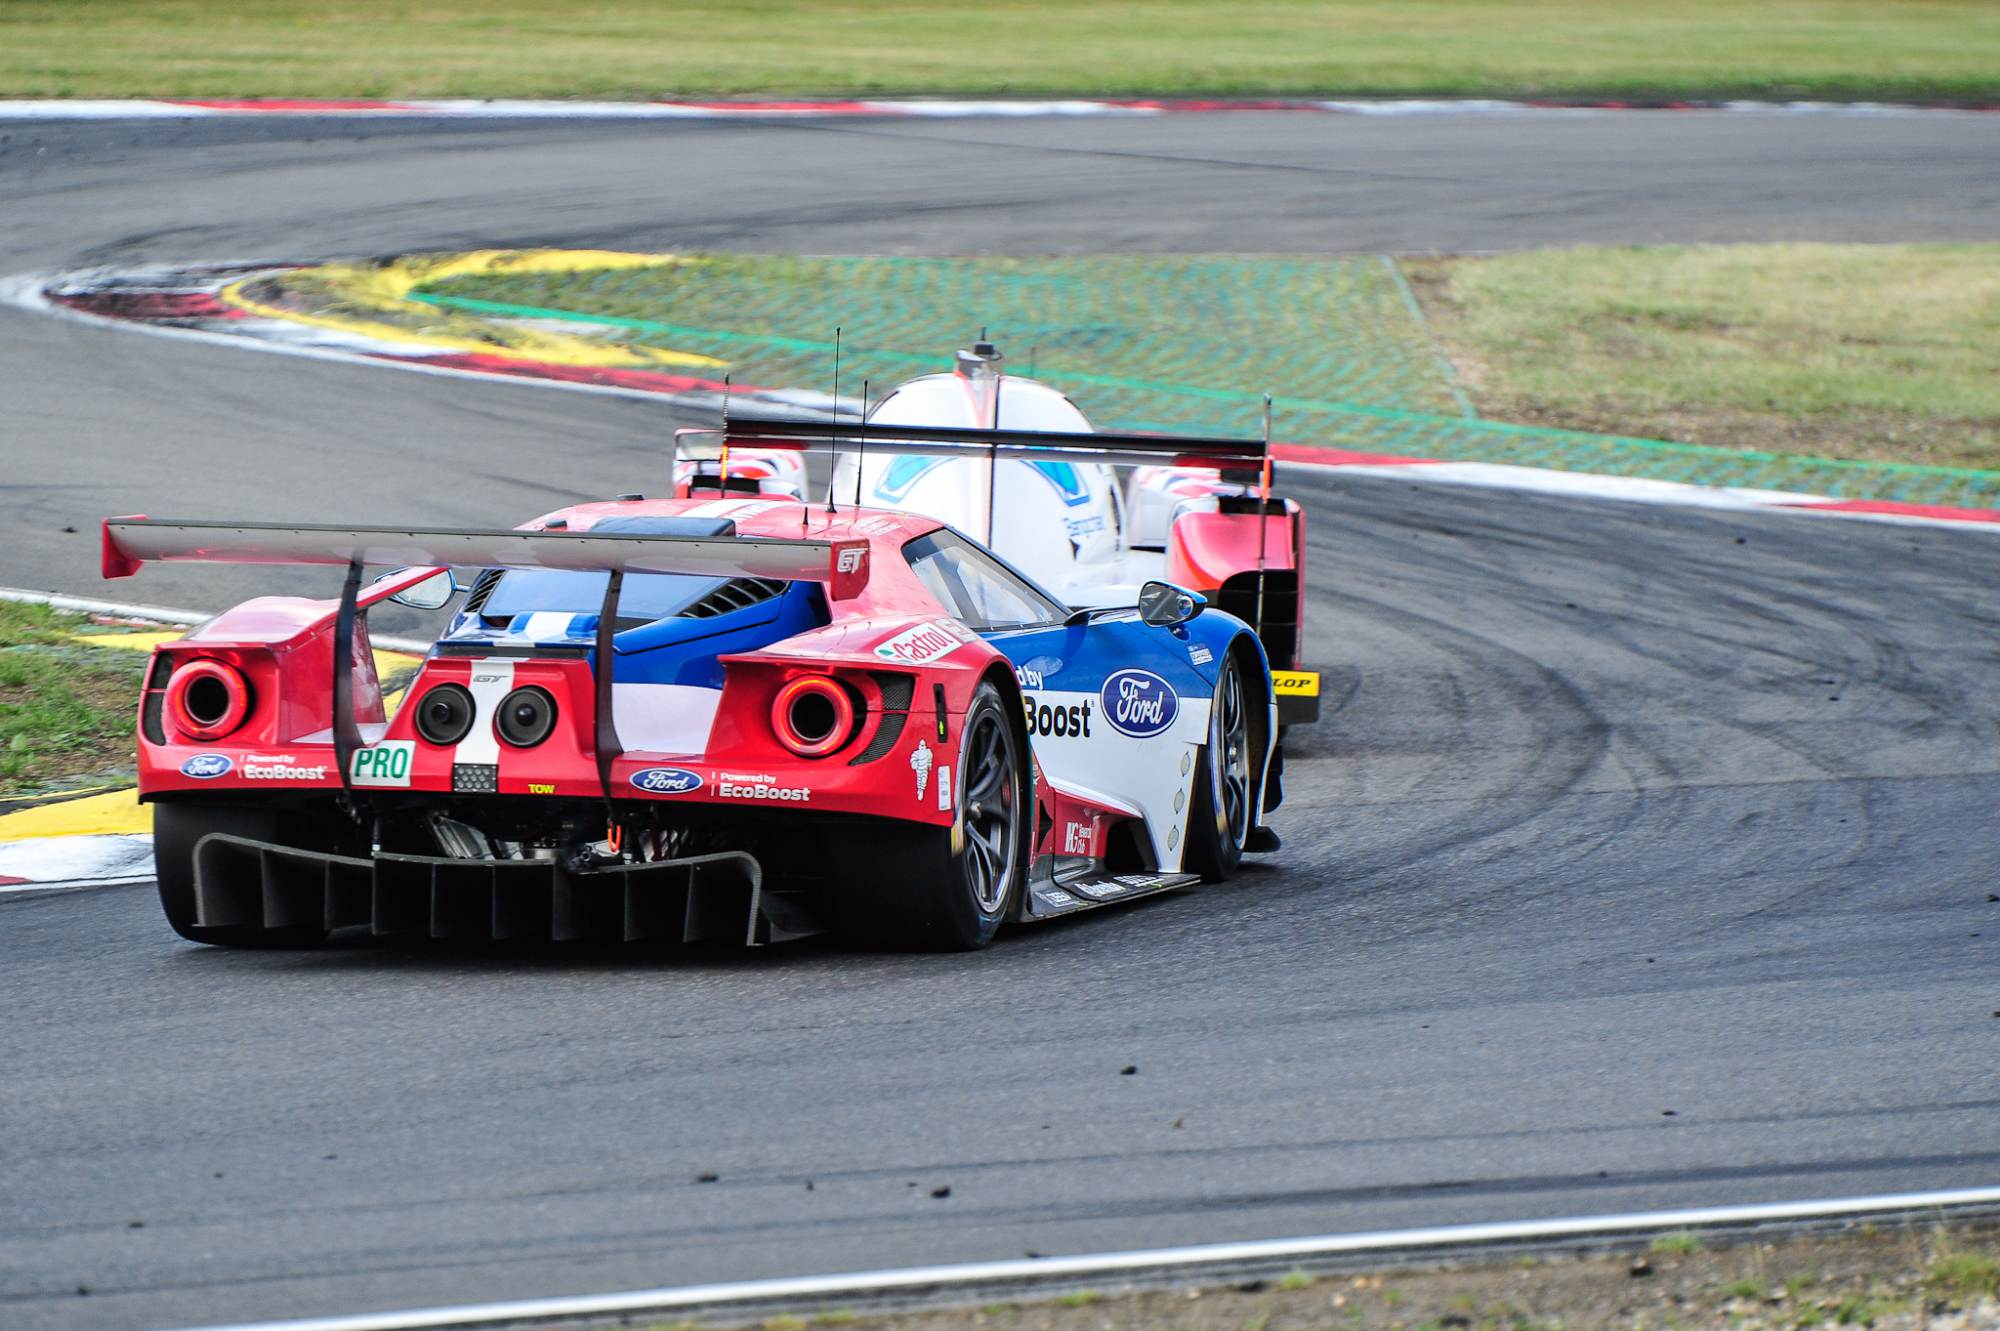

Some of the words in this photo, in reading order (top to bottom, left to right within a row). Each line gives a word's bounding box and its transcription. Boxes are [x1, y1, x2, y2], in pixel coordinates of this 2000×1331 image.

[837, 548, 868, 574] GT
[892, 627, 954, 662] Castrol
[1023, 665, 1044, 691] by
[1272, 678, 1311, 688] LOP
[1116, 677, 1164, 724] Ford
[1023, 695, 1091, 738] Boost
[188, 757, 224, 775] Ford
[247, 755, 282, 763] Powered
[283, 755, 296, 765] by
[354, 748, 409, 779] PRO
[244, 764, 325, 780] EcoBoost
[643, 770, 690, 790] Ford
[720, 772, 763, 783] Powered
[763, 774, 777, 784] by
[528, 784, 555, 794] TOW
[719, 783, 811, 801] EcoBoost
